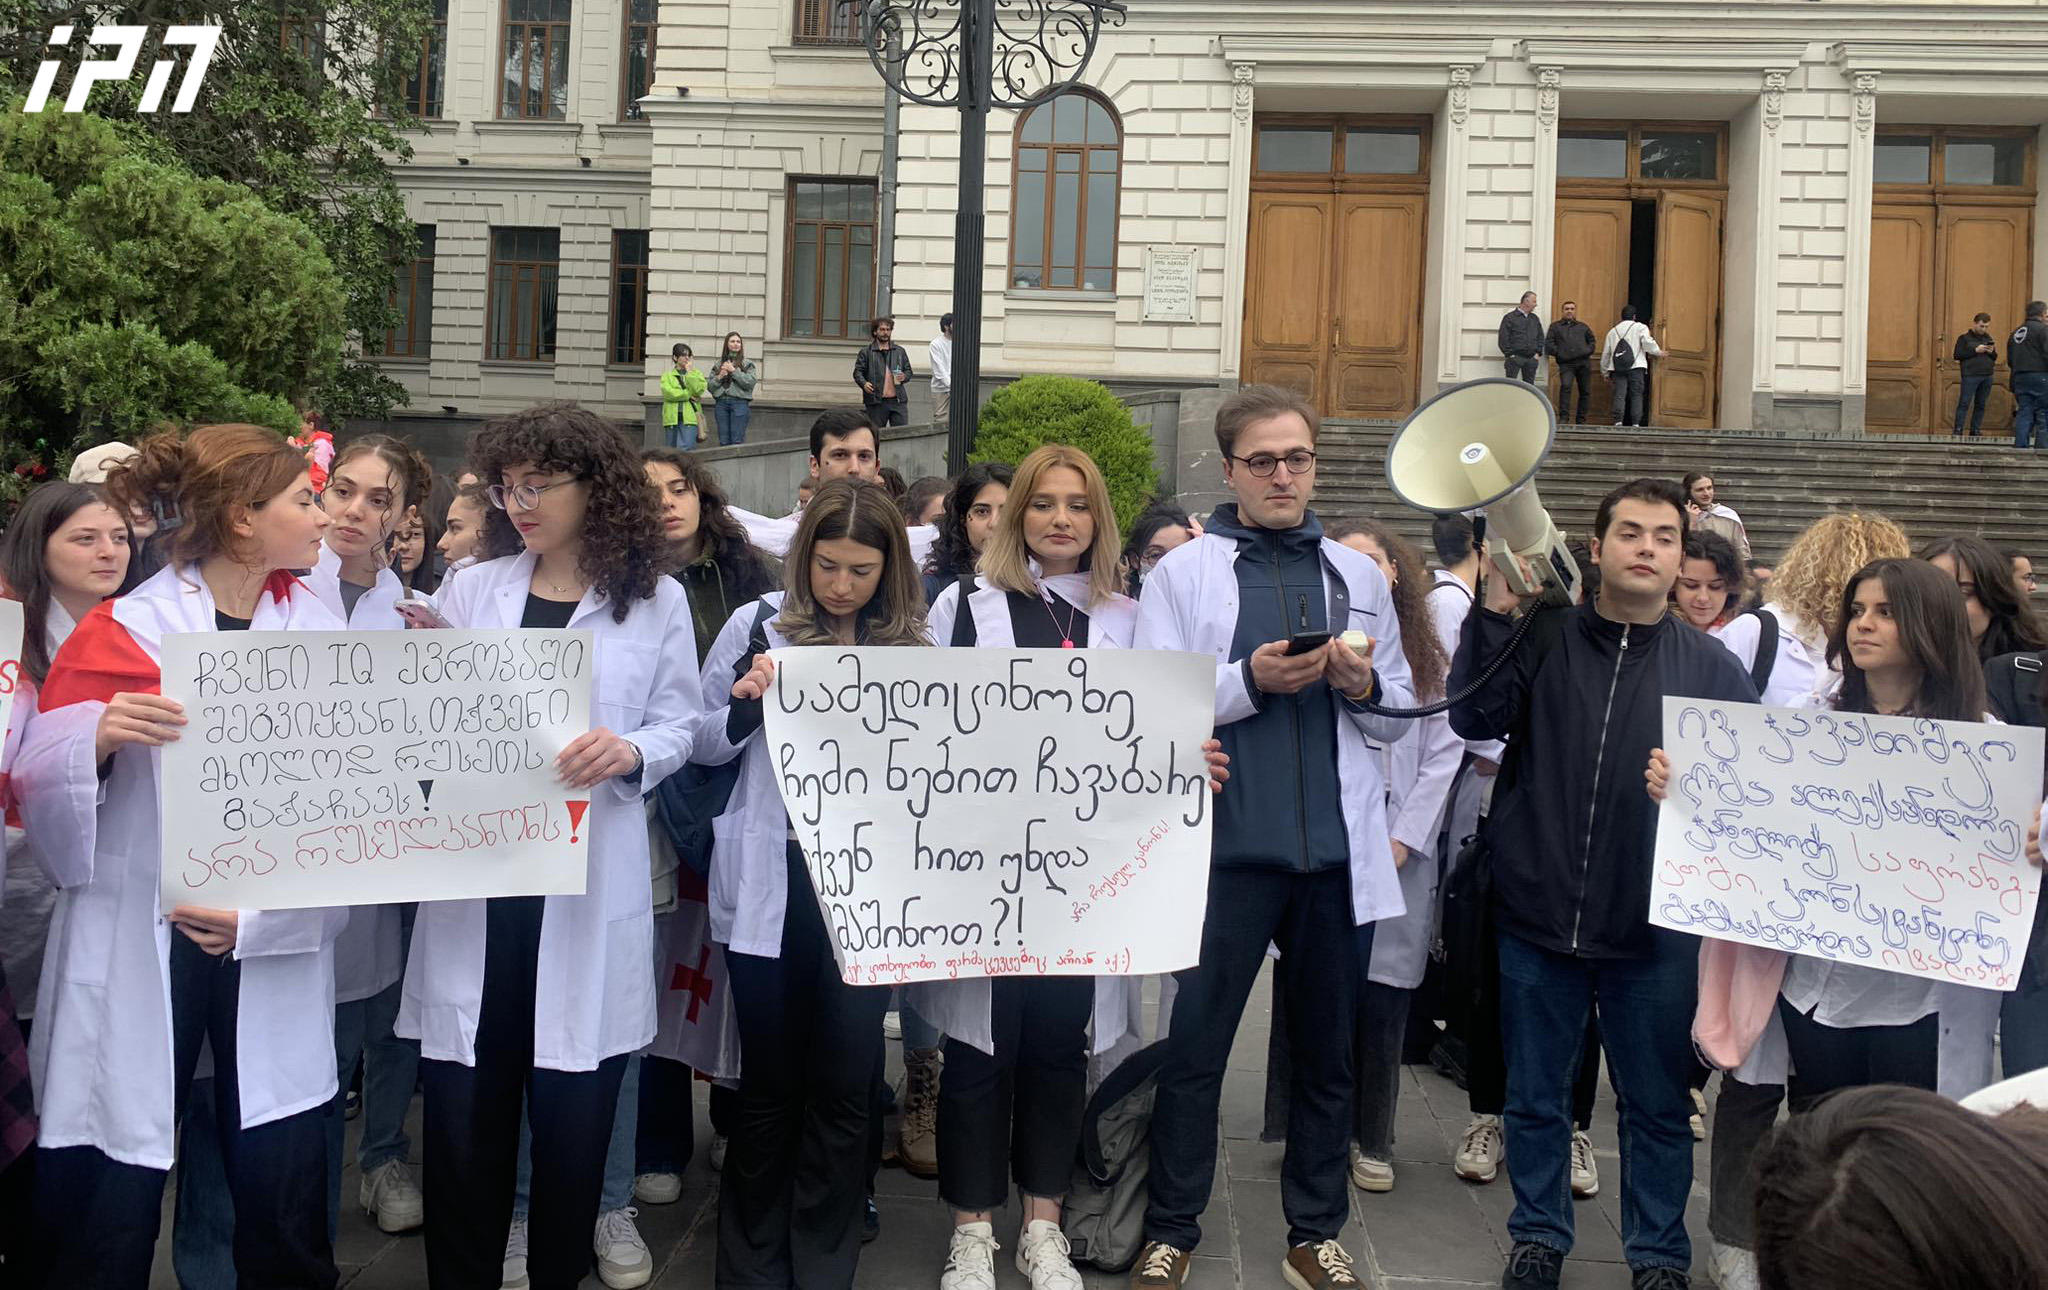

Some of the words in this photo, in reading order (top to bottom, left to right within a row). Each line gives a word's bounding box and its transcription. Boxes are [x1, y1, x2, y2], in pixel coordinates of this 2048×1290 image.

[193, 644, 310, 698] ჩვენი
[328, 642, 375, 687] IQ
[398, 636, 584, 685] ევროპაში
[777, 653, 1136, 742] სამედიცინოზე
[199, 744, 383, 792] მხოლოდ
[394, 738, 544, 774] რუსეთს
[780, 737, 869, 826] ჩემი
[885, 736, 1018, 819] ნებით
[1035, 735, 1206, 828] ჩავაბარე
[182, 834, 278, 888] არა
[914, 819, 985, 873] რით
[998, 818, 1090, 895] უნდა
